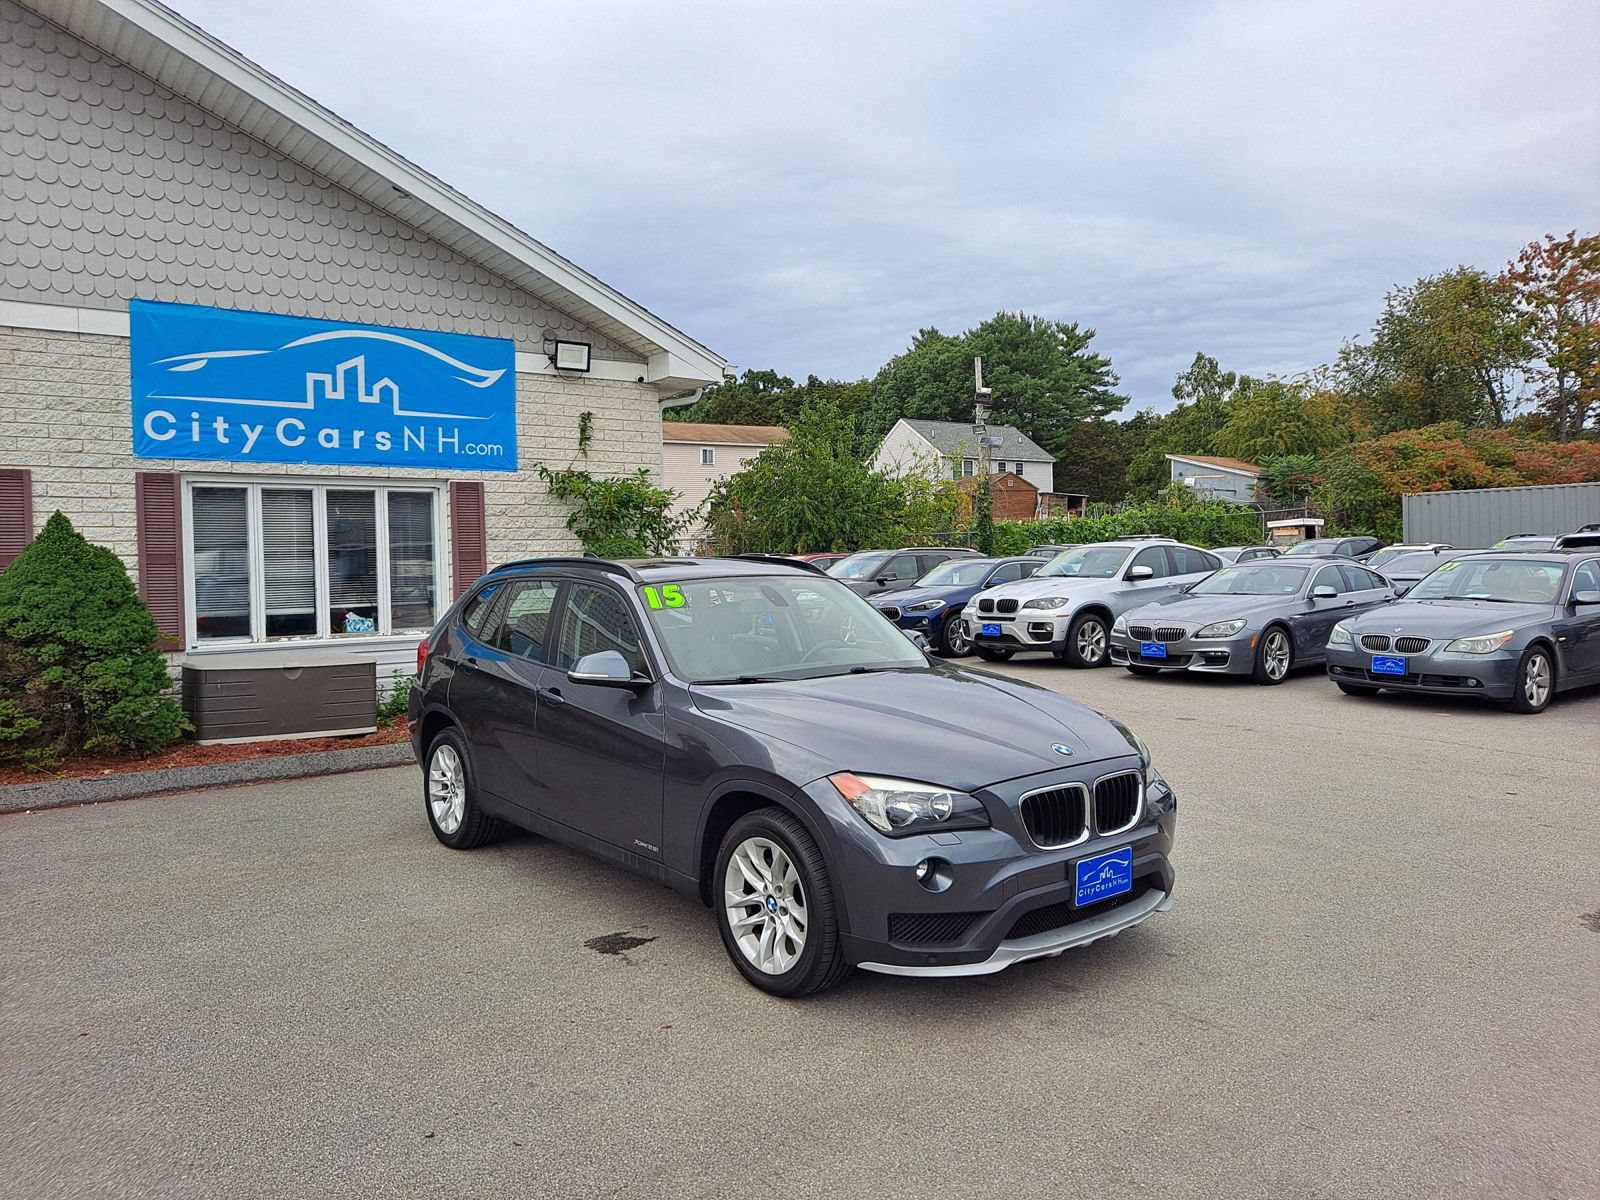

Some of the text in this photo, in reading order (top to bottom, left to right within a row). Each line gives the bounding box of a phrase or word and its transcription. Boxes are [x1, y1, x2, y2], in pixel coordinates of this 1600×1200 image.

[143, 410, 503, 456] CityCarsNH.com
[644, 584, 686, 609] 15
[1078, 877, 1129, 897] CityCarsNH
